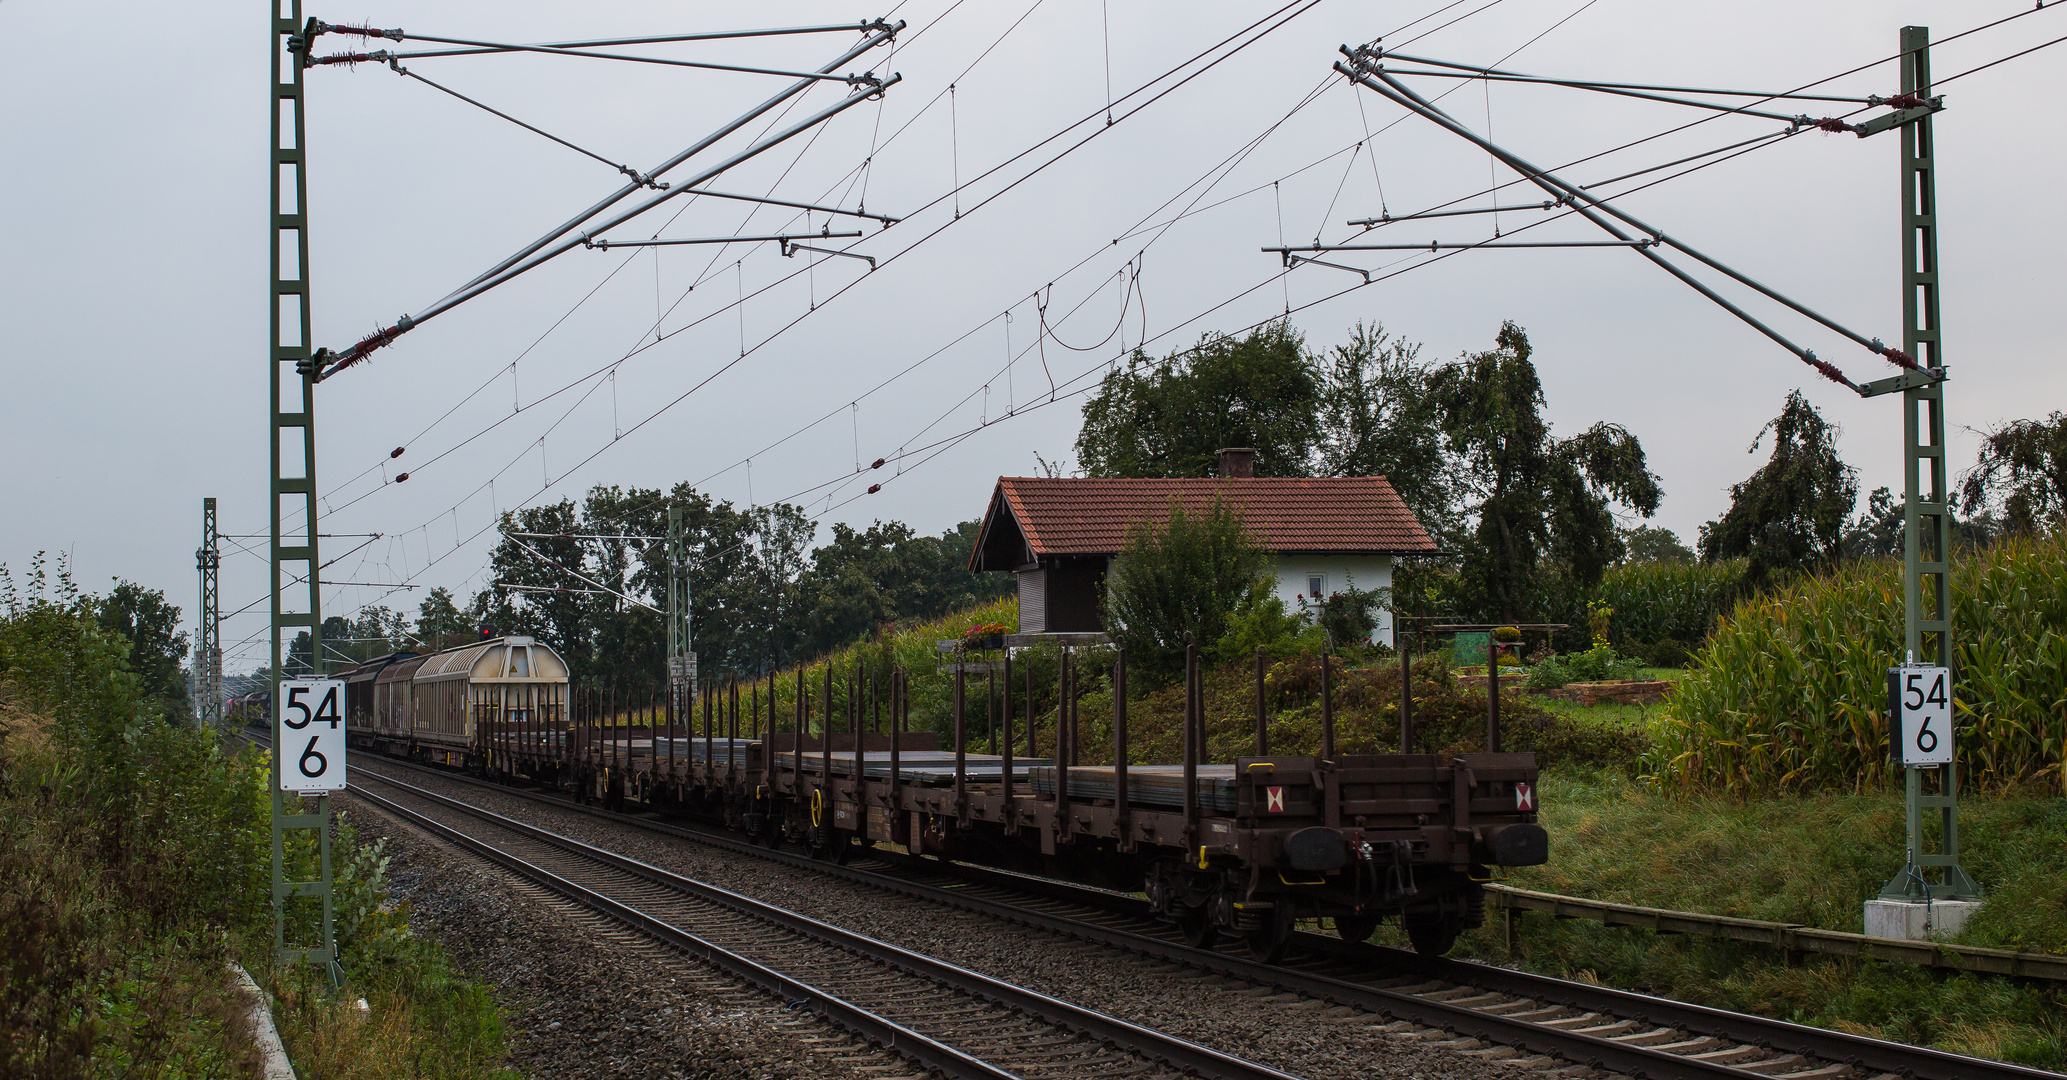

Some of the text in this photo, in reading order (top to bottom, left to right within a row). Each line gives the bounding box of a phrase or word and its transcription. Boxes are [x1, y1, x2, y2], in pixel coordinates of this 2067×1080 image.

[284, 687, 341, 730] 54
[1904, 674, 1947, 711] 54
[1917, 717, 1938, 753] 6
[299, 736, 328, 778] 6
